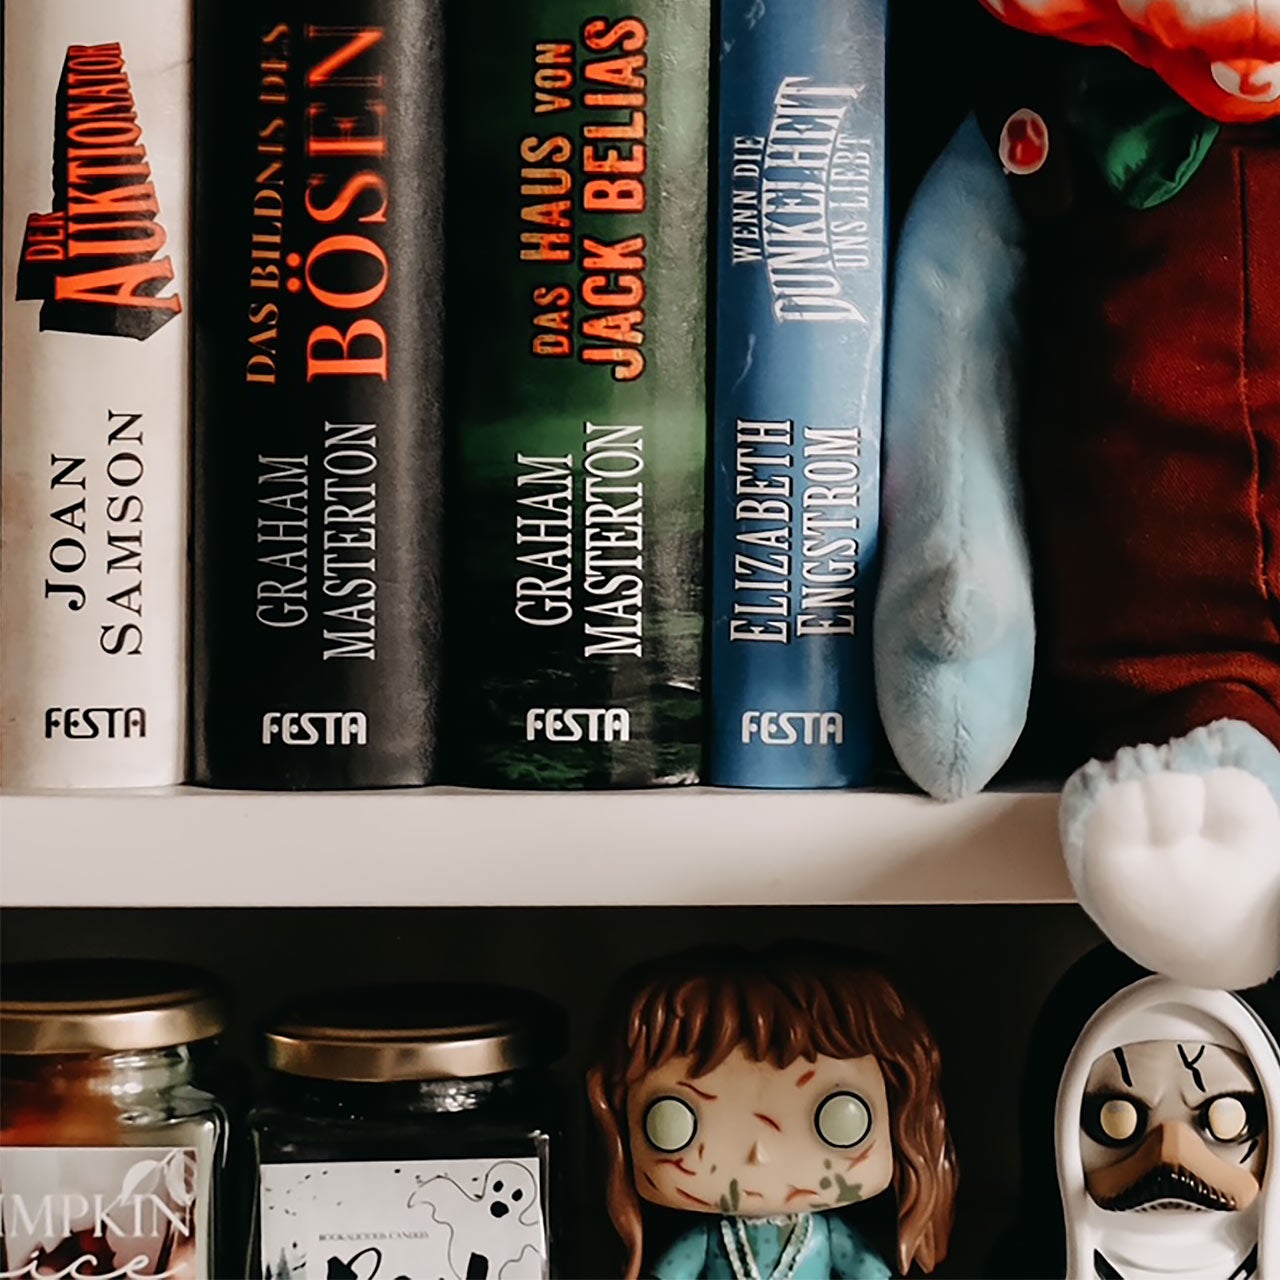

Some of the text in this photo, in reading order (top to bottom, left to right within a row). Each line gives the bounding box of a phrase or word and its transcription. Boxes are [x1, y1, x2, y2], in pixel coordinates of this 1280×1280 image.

[25, 211, 67, 262] DER
[54, 42, 183, 316] AUKTIONATOR
[246, 23, 290, 384] DAS BILDNIS DES
[286, 25, 390, 383] BÖSEN
[520, 43, 574, 355] DAS HAUS VON
[581, 18, 649, 380] JACK BELIAS
[733, 136, 766, 265] WENN DIE
[762, 76, 869, 325] DUNKELHEIT
[829, 133, 873, 268] UNS LIEBT
[45, 453, 87, 611] JOAN
[100, 409, 144, 656] SAMSON
[256, 454, 309, 628] GRAHAM
[322, 421, 377, 661] MASTERTON
[514, 453, 573, 627] GRAHAM
[583, 421, 644, 658] MASTERTON
[729, 418, 792, 644] ELIZABETH
[796, 425, 861, 637] ENGSTROM
[45, 707, 147, 739] FESTA
[262, 710, 368, 746] FESTA
[526, 707, 630, 743] FESTA
[741, 710, 844, 745] FESTA
[0, 1193, 191, 1238] MPKIN
[0, 1250, 188, 1280] ice
